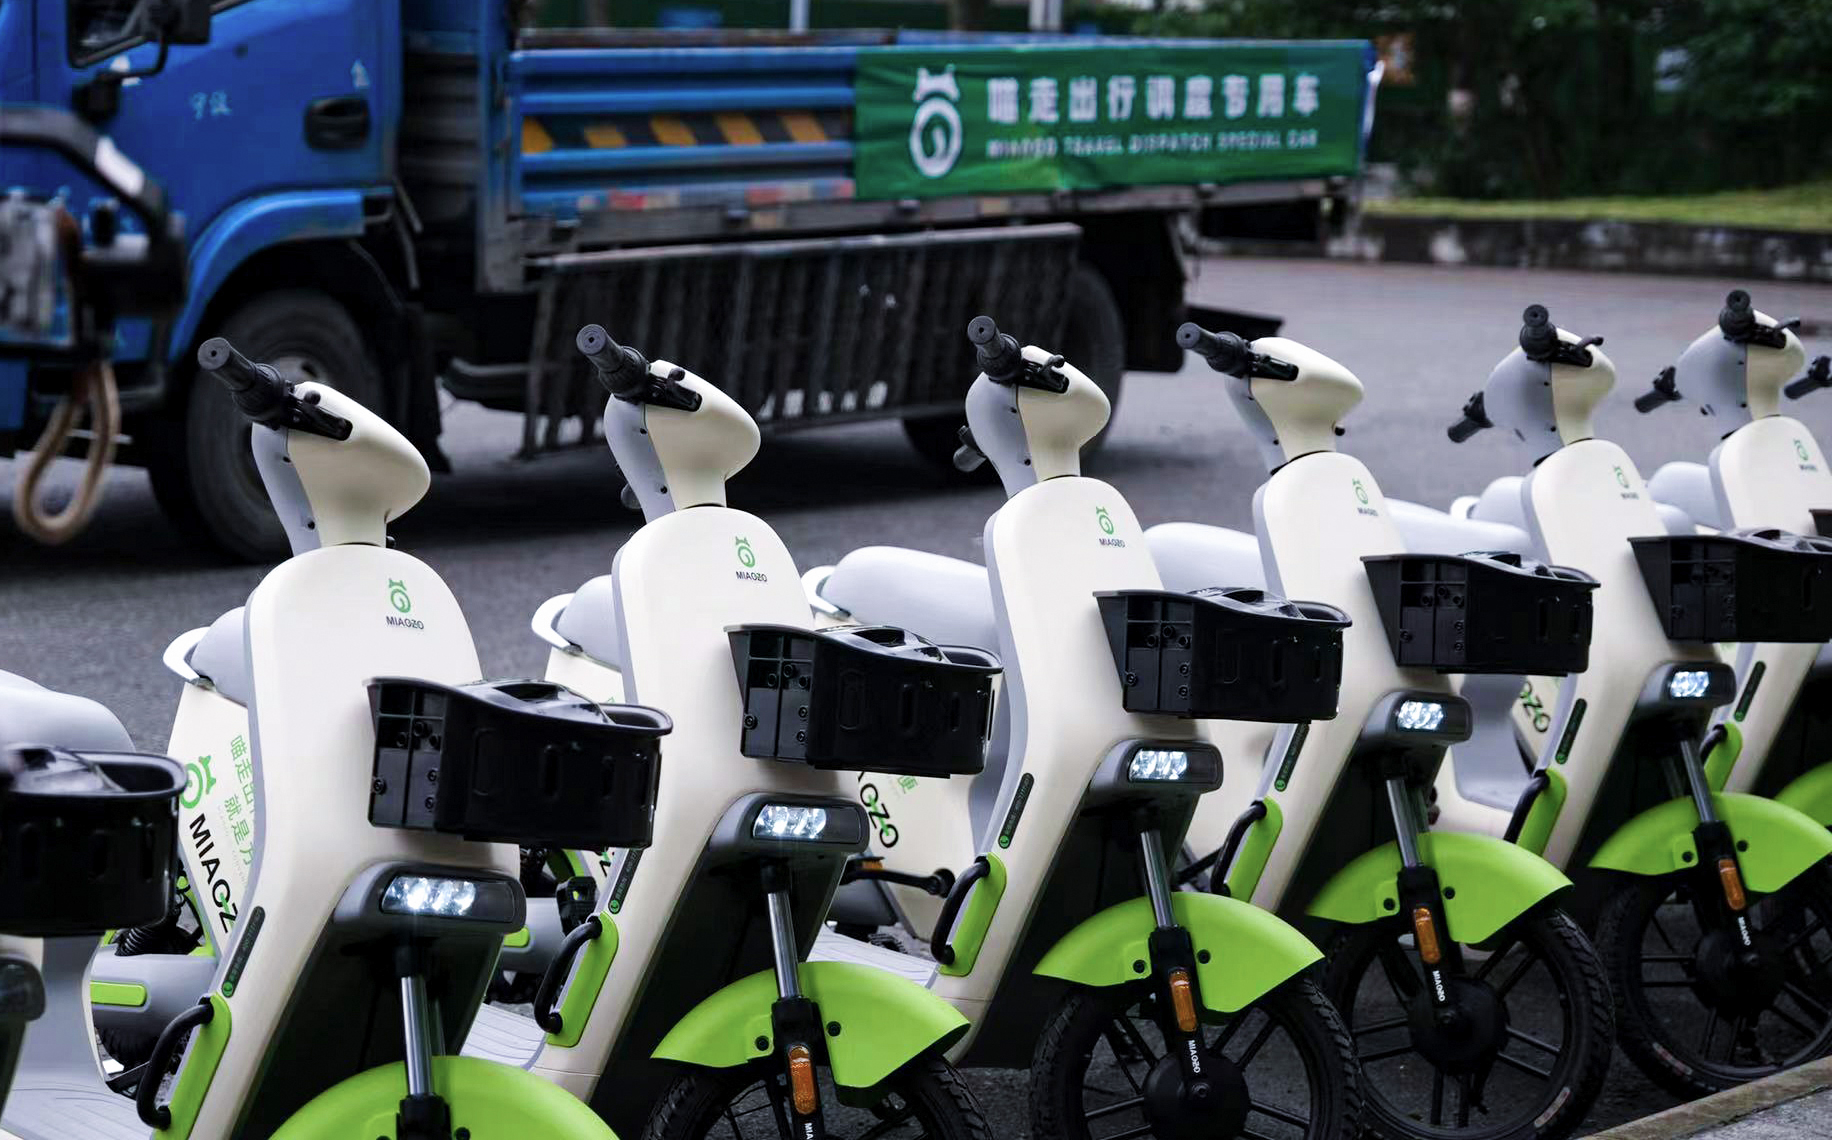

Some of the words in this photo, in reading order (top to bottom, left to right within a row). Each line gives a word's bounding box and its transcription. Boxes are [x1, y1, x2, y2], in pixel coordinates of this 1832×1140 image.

[735, 570, 768, 583] MIAOZO
[385, 615, 425, 630] MIAOZO
[231, 735, 255, 813] 喵走出
[1188, 1039, 1201, 1074] MIAOZO
